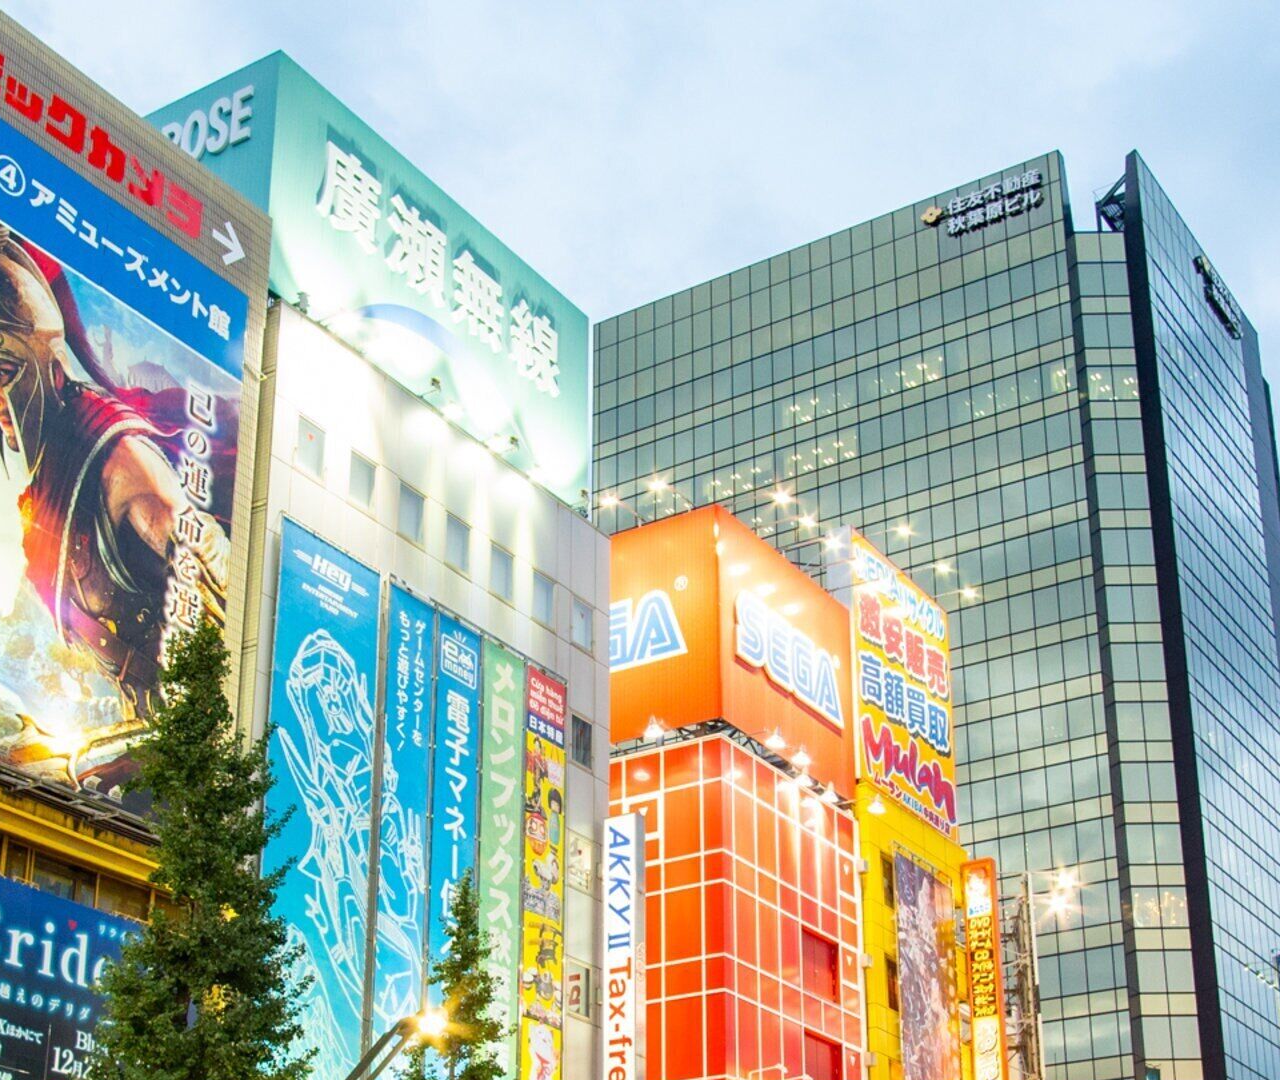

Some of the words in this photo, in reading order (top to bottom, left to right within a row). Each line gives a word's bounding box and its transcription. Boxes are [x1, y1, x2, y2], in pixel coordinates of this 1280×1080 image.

[29, 178, 231, 341] アミューズメント館
[947, 189, 1042, 235] 秋葉原ビル
[736, 589, 844, 731] SEGA
[859, 654, 951, 752] 高額買取
[608, 825, 631, 929] AKKY
